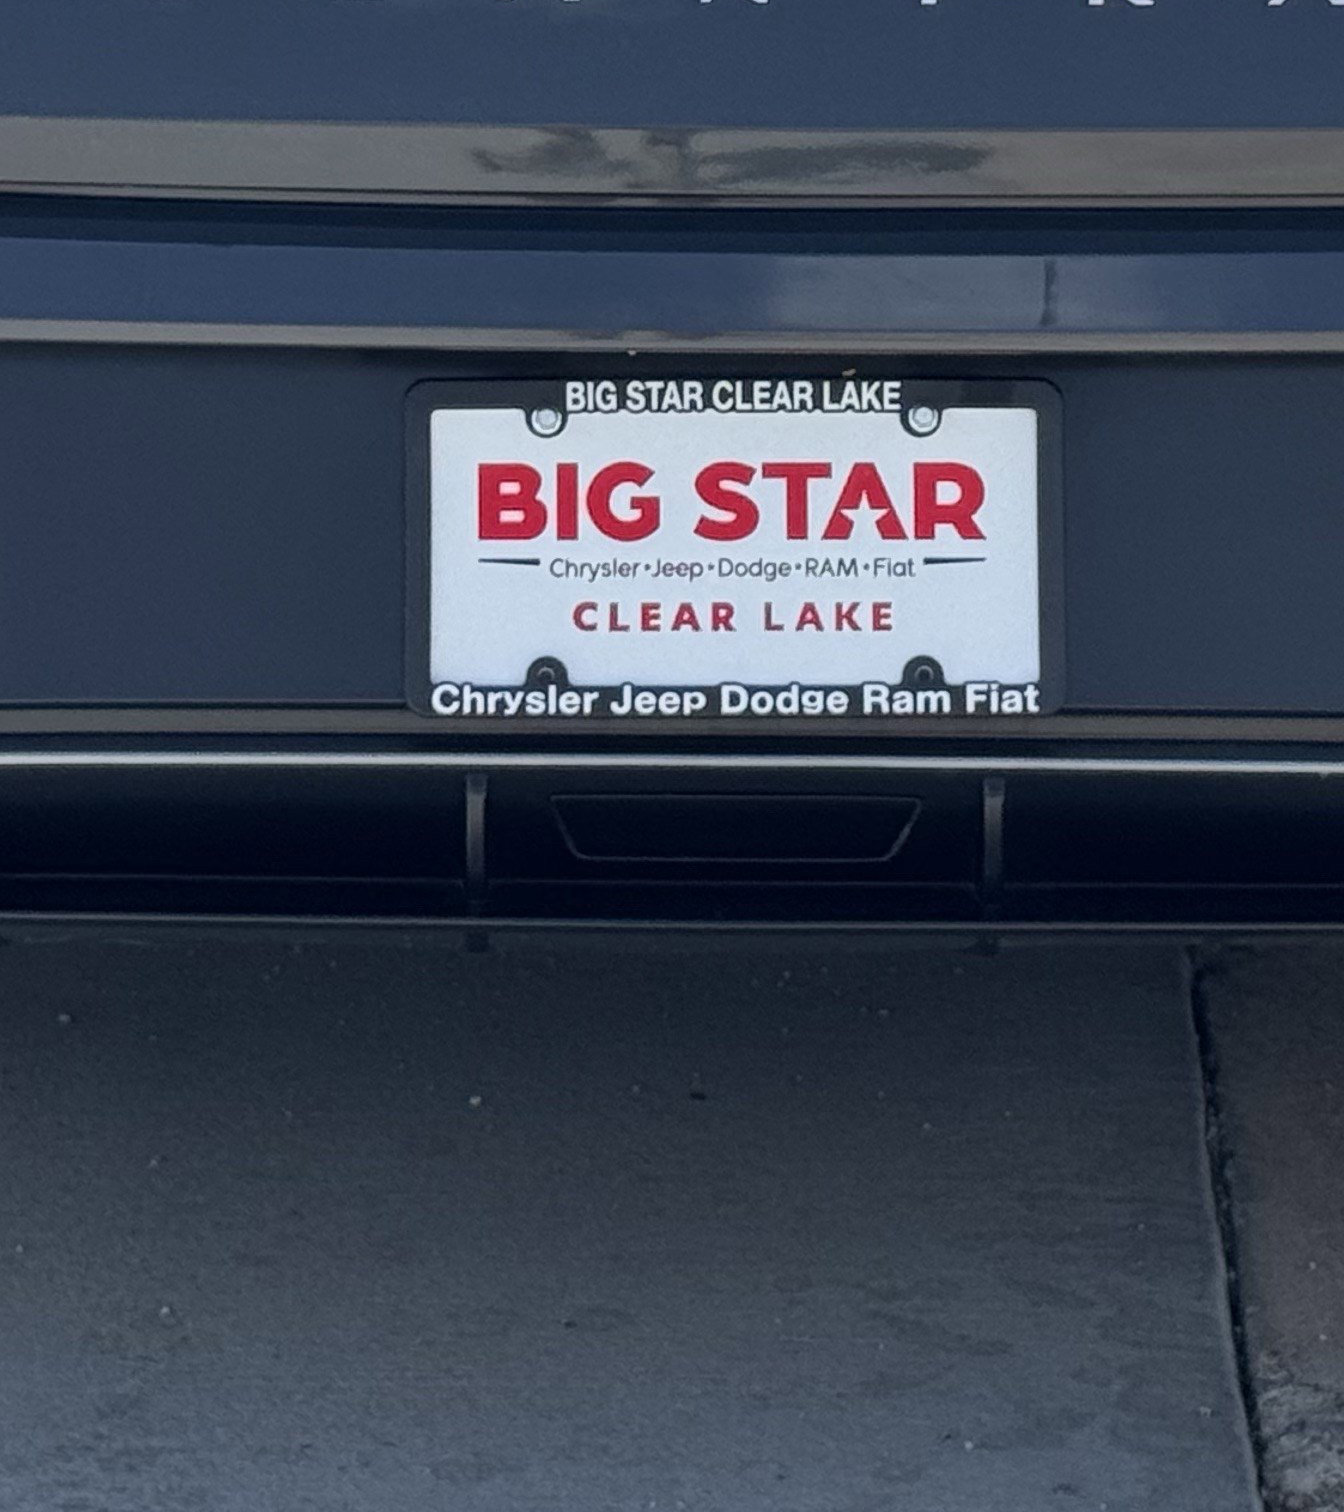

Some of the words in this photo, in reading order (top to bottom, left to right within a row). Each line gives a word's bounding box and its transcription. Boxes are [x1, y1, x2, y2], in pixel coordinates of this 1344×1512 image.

[565, 380, 618, 411] BIG
[625, 380, 704, 411] STAR
[712, 380, 814, 411] CLEAR
[822, 380, 902, 411] LAKE
[477, 462, 660, 540] BIG
[693, 462, 986, 541] STAR
[572, 601, 737, 631] CLEAR
[764, 601, 893, 631] LAKE
[431, 684, 600, 716] Chrysler
[609, 684, 707, 716] Jeep
[720, 684, 849, 715] Dodge
[862, 684, 951, 714] Ram
[965, 684, 1041, 714] Fiat
